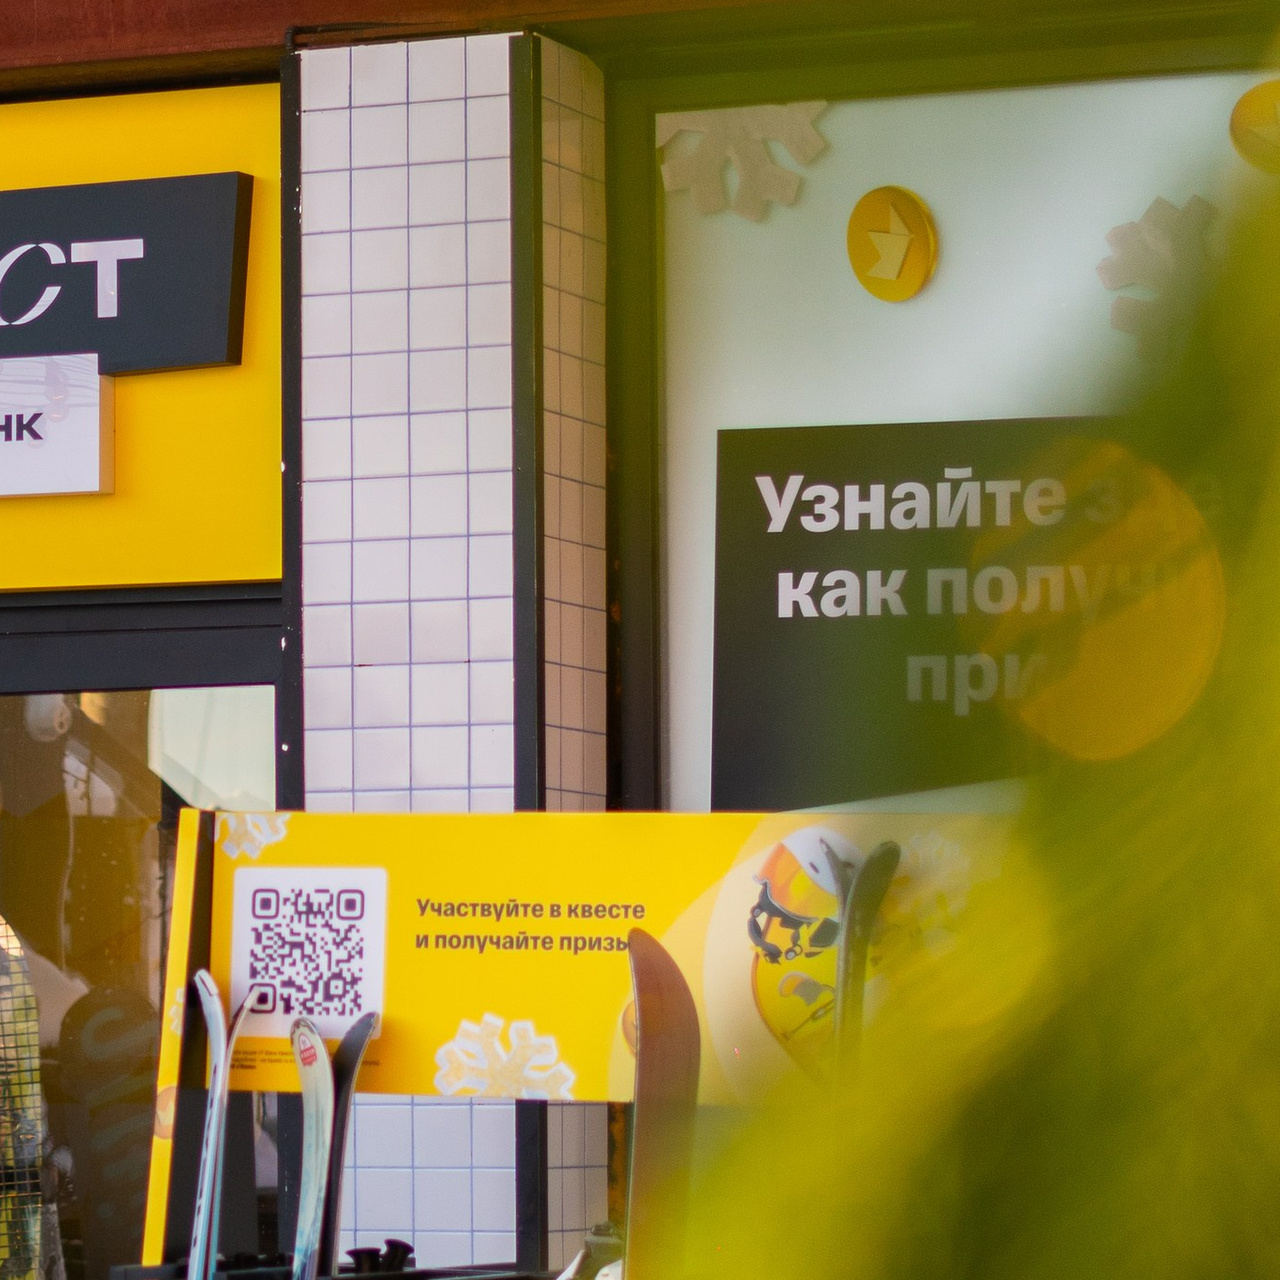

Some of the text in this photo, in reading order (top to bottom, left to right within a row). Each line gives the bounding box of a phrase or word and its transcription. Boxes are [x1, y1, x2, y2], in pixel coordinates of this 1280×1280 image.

[755, 466, 1067, 534] Узнайте
[777, 567, 908, 619] как
[416, 898, 646, 922] Участвуйте в квесте
[415, 934, 429, 949] и
[434, 931, 554, 955] получайте
